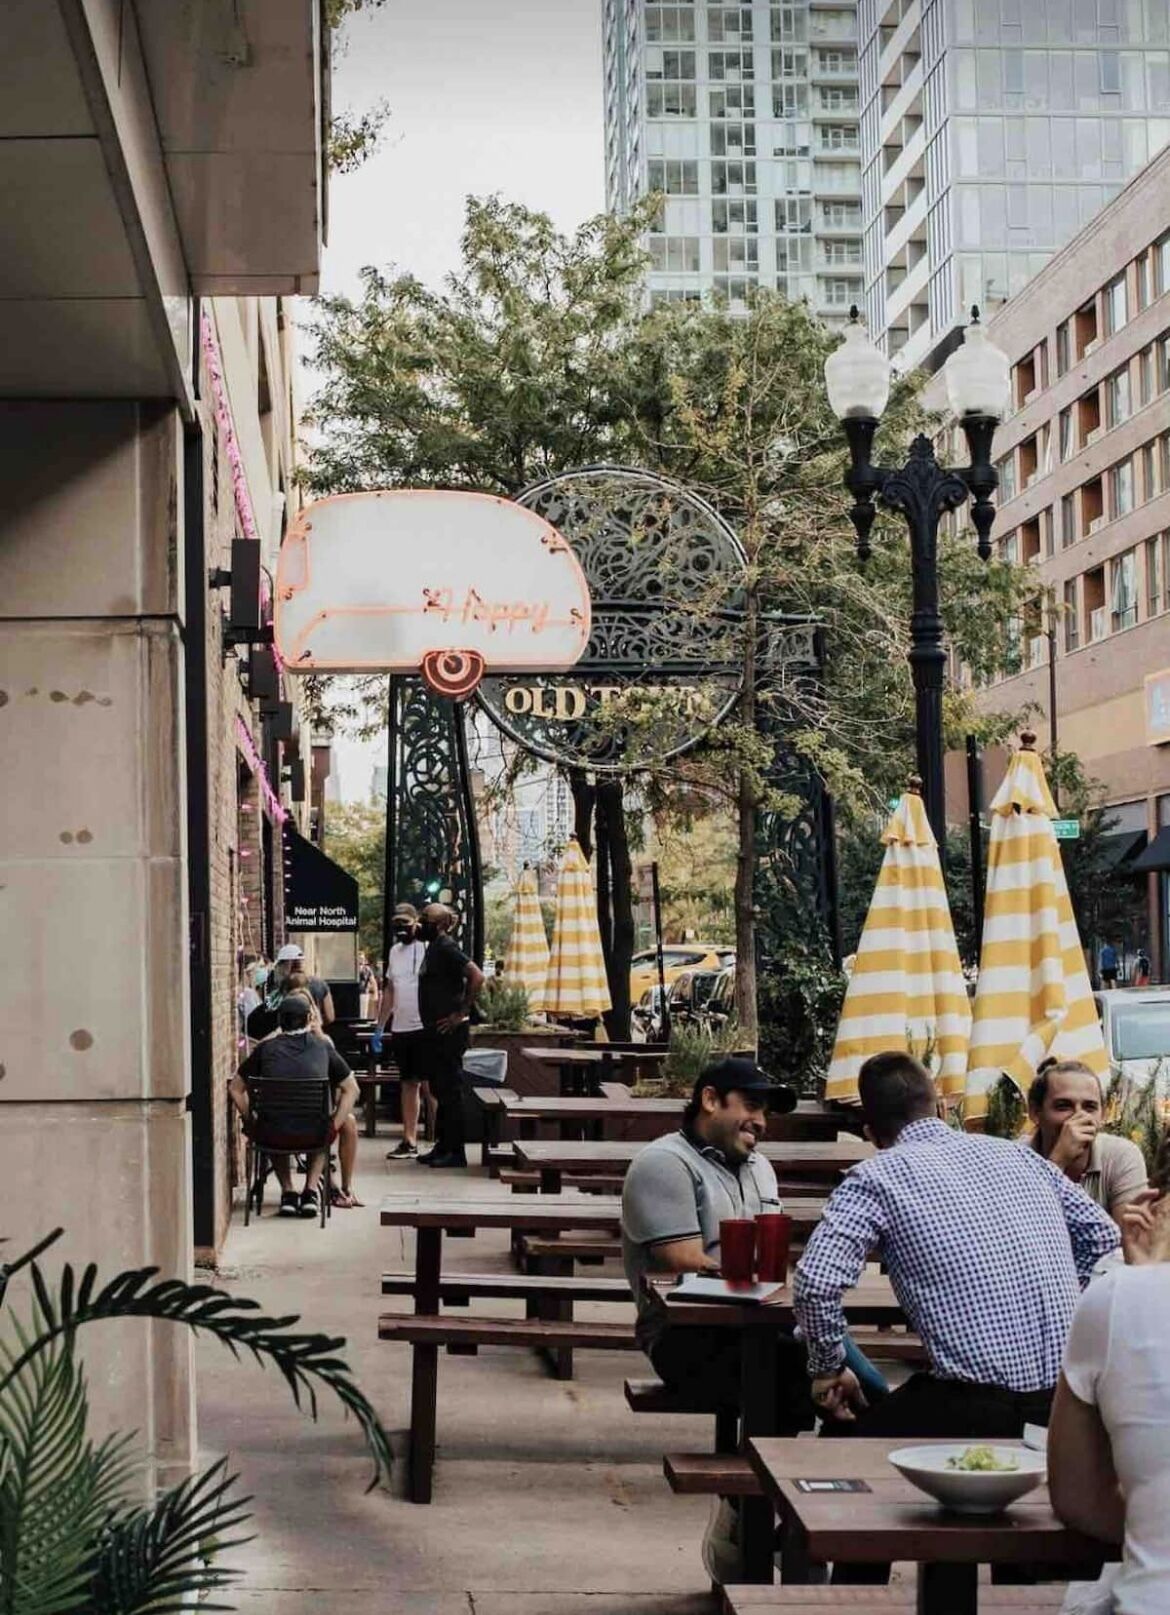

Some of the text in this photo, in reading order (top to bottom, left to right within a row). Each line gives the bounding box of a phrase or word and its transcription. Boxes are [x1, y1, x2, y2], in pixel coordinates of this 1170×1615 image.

[505, 686, 586, 720] OLD
[294, 906, 346, 916] Near North
[285, 916, 357, 927] Animal Hospital
